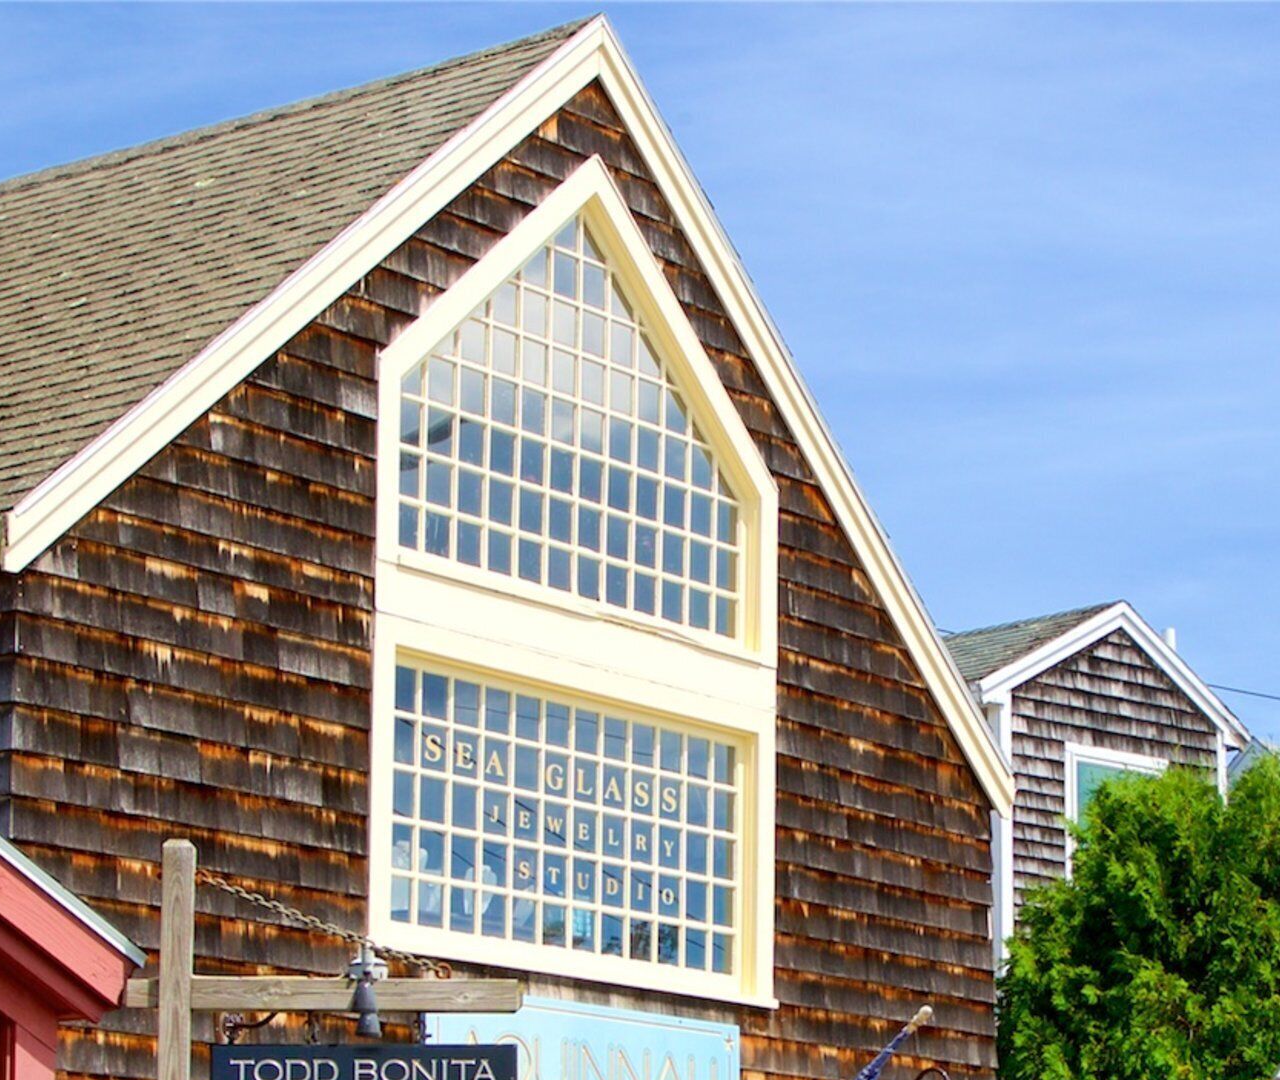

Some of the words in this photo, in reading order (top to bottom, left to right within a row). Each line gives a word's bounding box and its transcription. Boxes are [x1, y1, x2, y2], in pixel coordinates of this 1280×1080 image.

[424, 733, 505, 778] SEA
[544, 763, 678, 814] GLASS
[490, 804, 675, 859] JEWELRY
[518, 860, 676, 906] STUDIO
